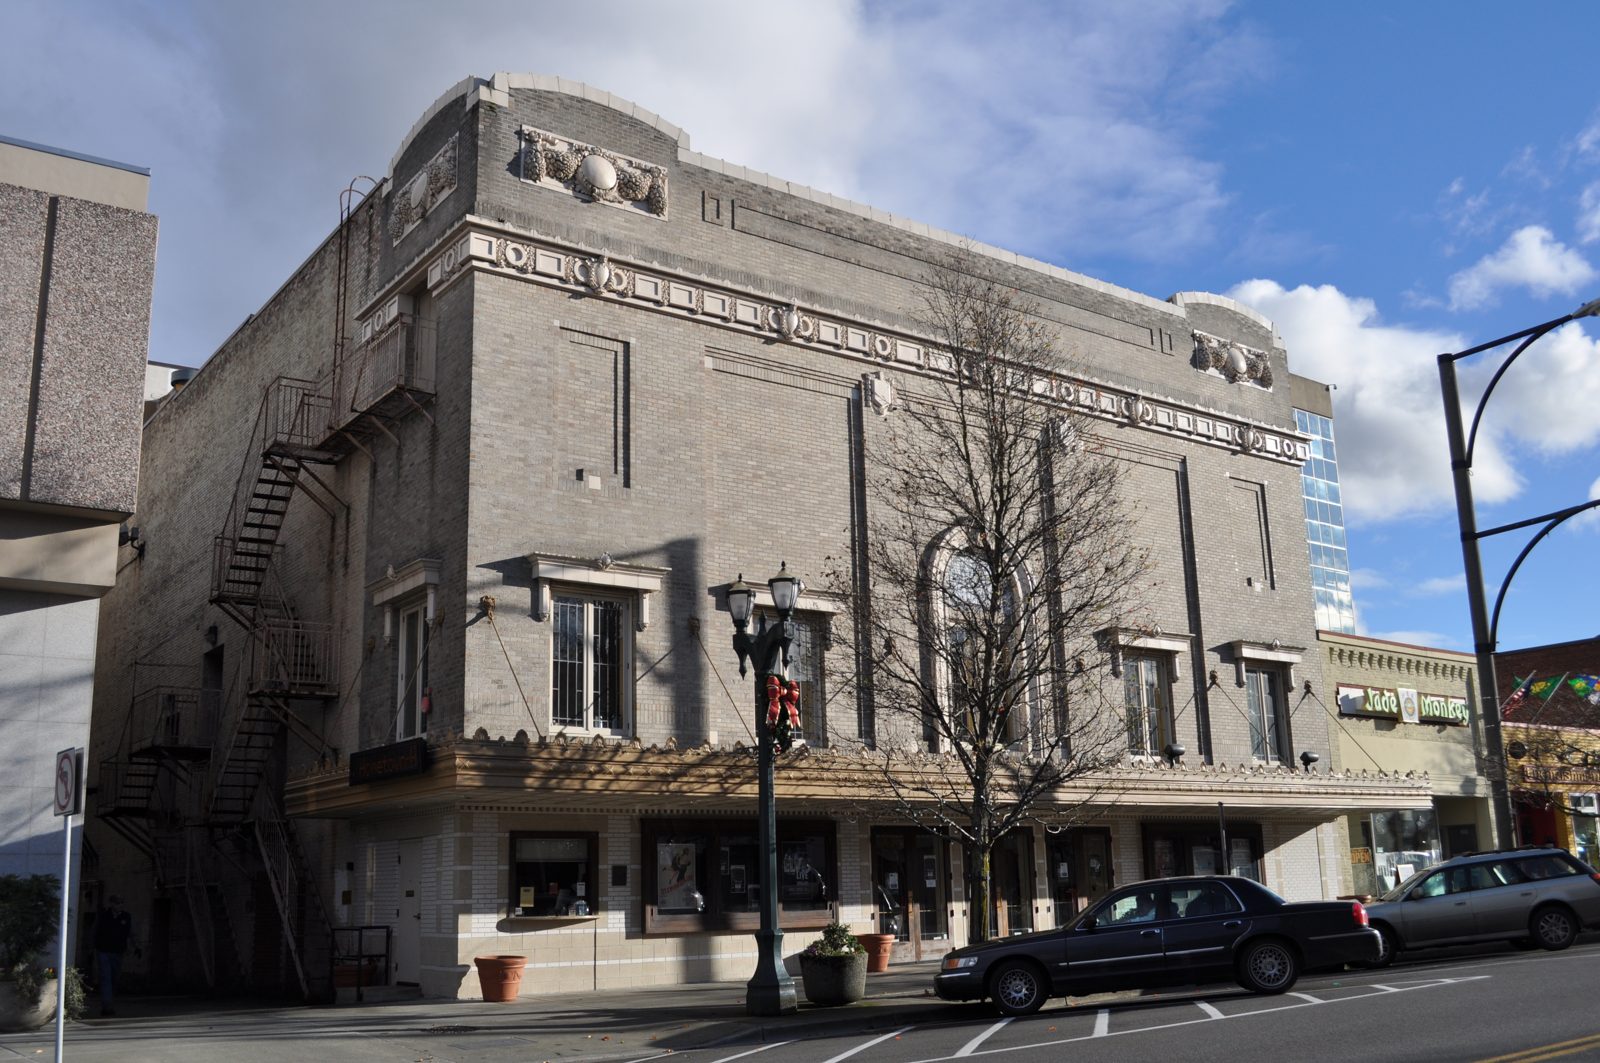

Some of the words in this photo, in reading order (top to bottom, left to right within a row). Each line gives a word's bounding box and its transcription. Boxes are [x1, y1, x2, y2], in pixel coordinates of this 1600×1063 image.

[1365, 687, 1399, 713] Jade
[1421, 694, 1469, 725] Monkey
[1351, 852, 1370, 864] OPEN
